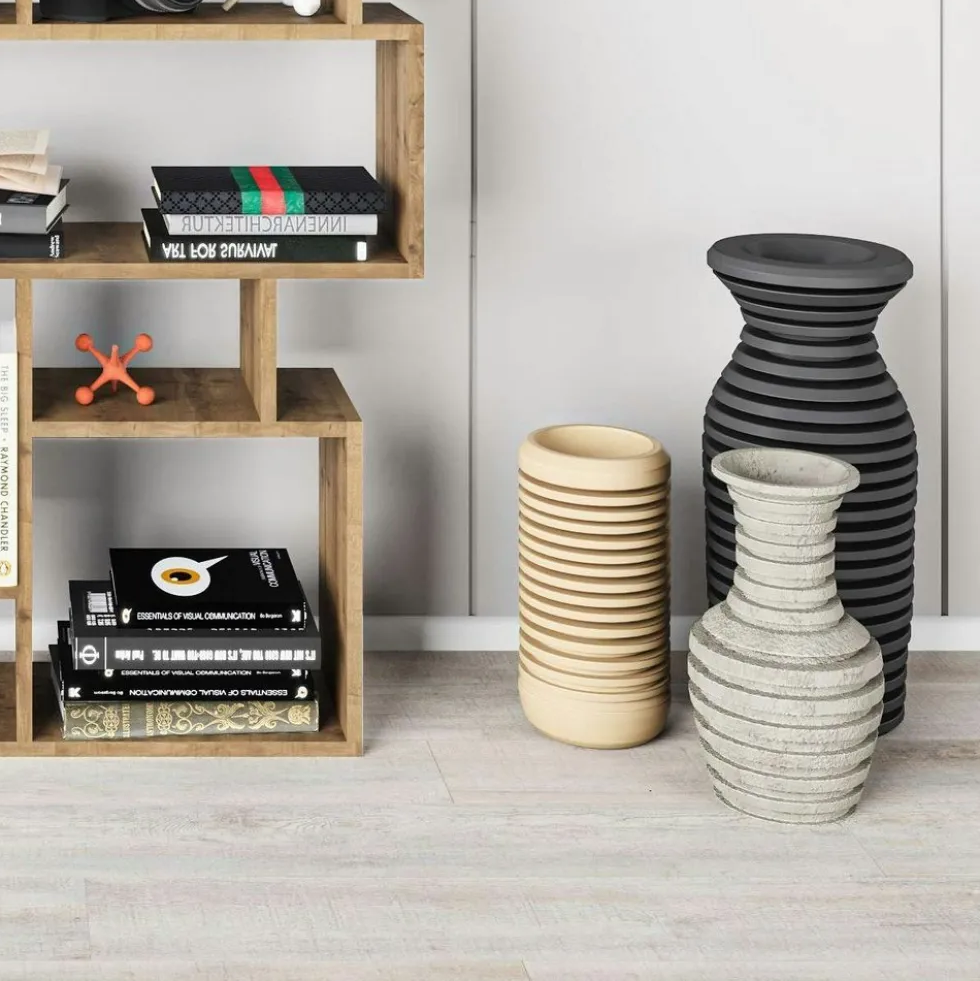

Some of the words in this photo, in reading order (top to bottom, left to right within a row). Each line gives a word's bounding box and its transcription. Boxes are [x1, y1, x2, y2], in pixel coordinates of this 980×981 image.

[0, 365, 9, 382] THE
[0, 386, 9, 403] BIG
[0, 407, 9, 433] SLEEP
[0, 447, 9, 497] RAYMOND
[0, 501, 9, 552] CHANDLER
[136, 612, 173, 620] ESSENTIALS
[173, 612, 182, 620] OF
[183, 612, 203, 620] VISUAL
[204, 612, 256, 620] COMMUNICATION
